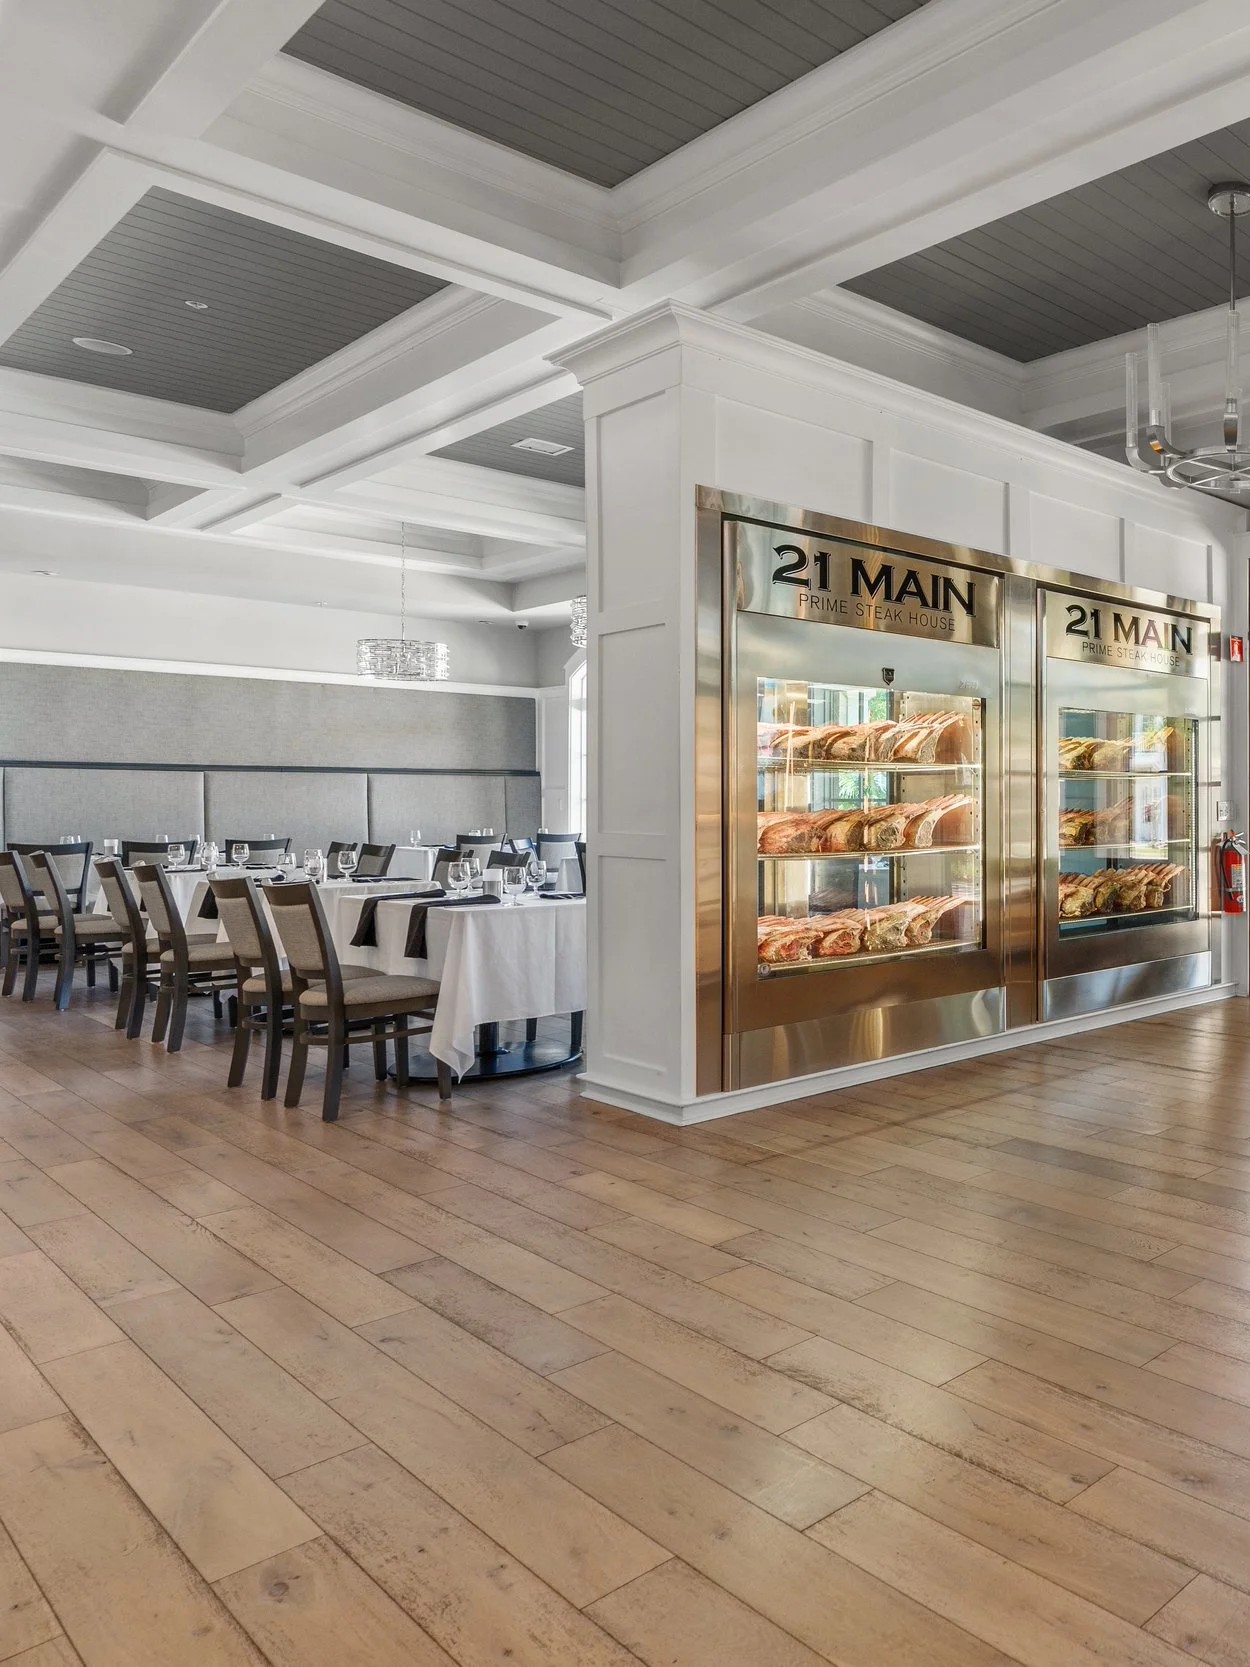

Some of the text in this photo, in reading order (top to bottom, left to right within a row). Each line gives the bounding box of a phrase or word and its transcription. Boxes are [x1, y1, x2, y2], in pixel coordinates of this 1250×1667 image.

[772, 544, 976, 617] 21 MAIN
[799, 593, 955, 632] PRIME STEAK HOUSE
[1065, 604, 1102, 640] 21
[1113, 612, 1193, 655] MAIN
[1082, 641, 1180, 667] PRIME STEAK HOUSE
